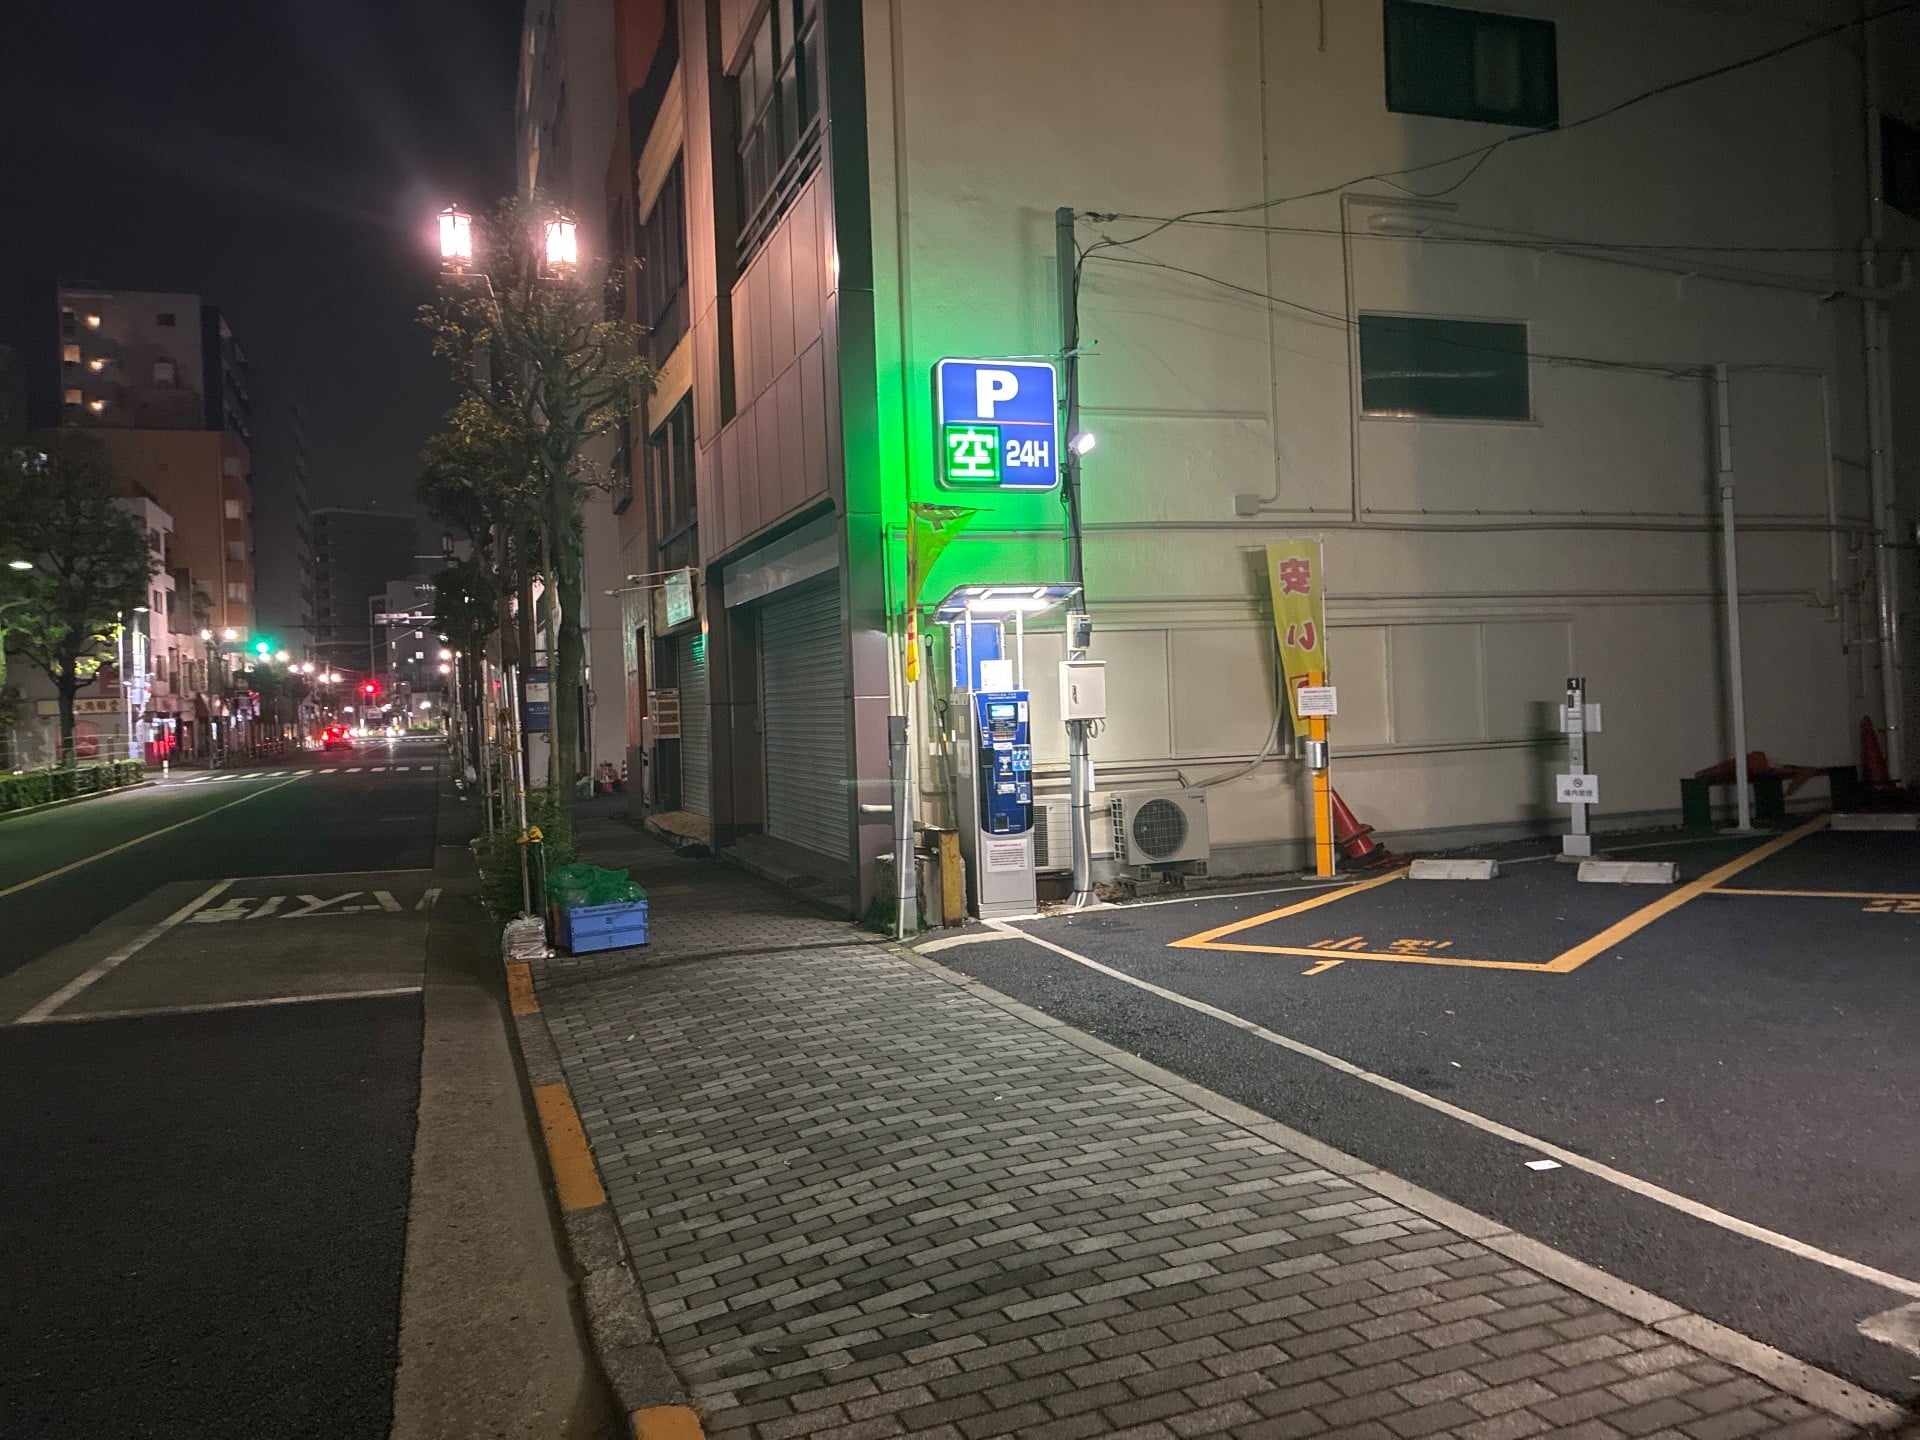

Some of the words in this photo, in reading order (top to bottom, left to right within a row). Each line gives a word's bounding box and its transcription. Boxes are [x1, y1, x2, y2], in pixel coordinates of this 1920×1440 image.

[976, 369, 1019, 418] P
[949, 427, 994, 477] 空
[1006, 440, 1049, 467] 24H
